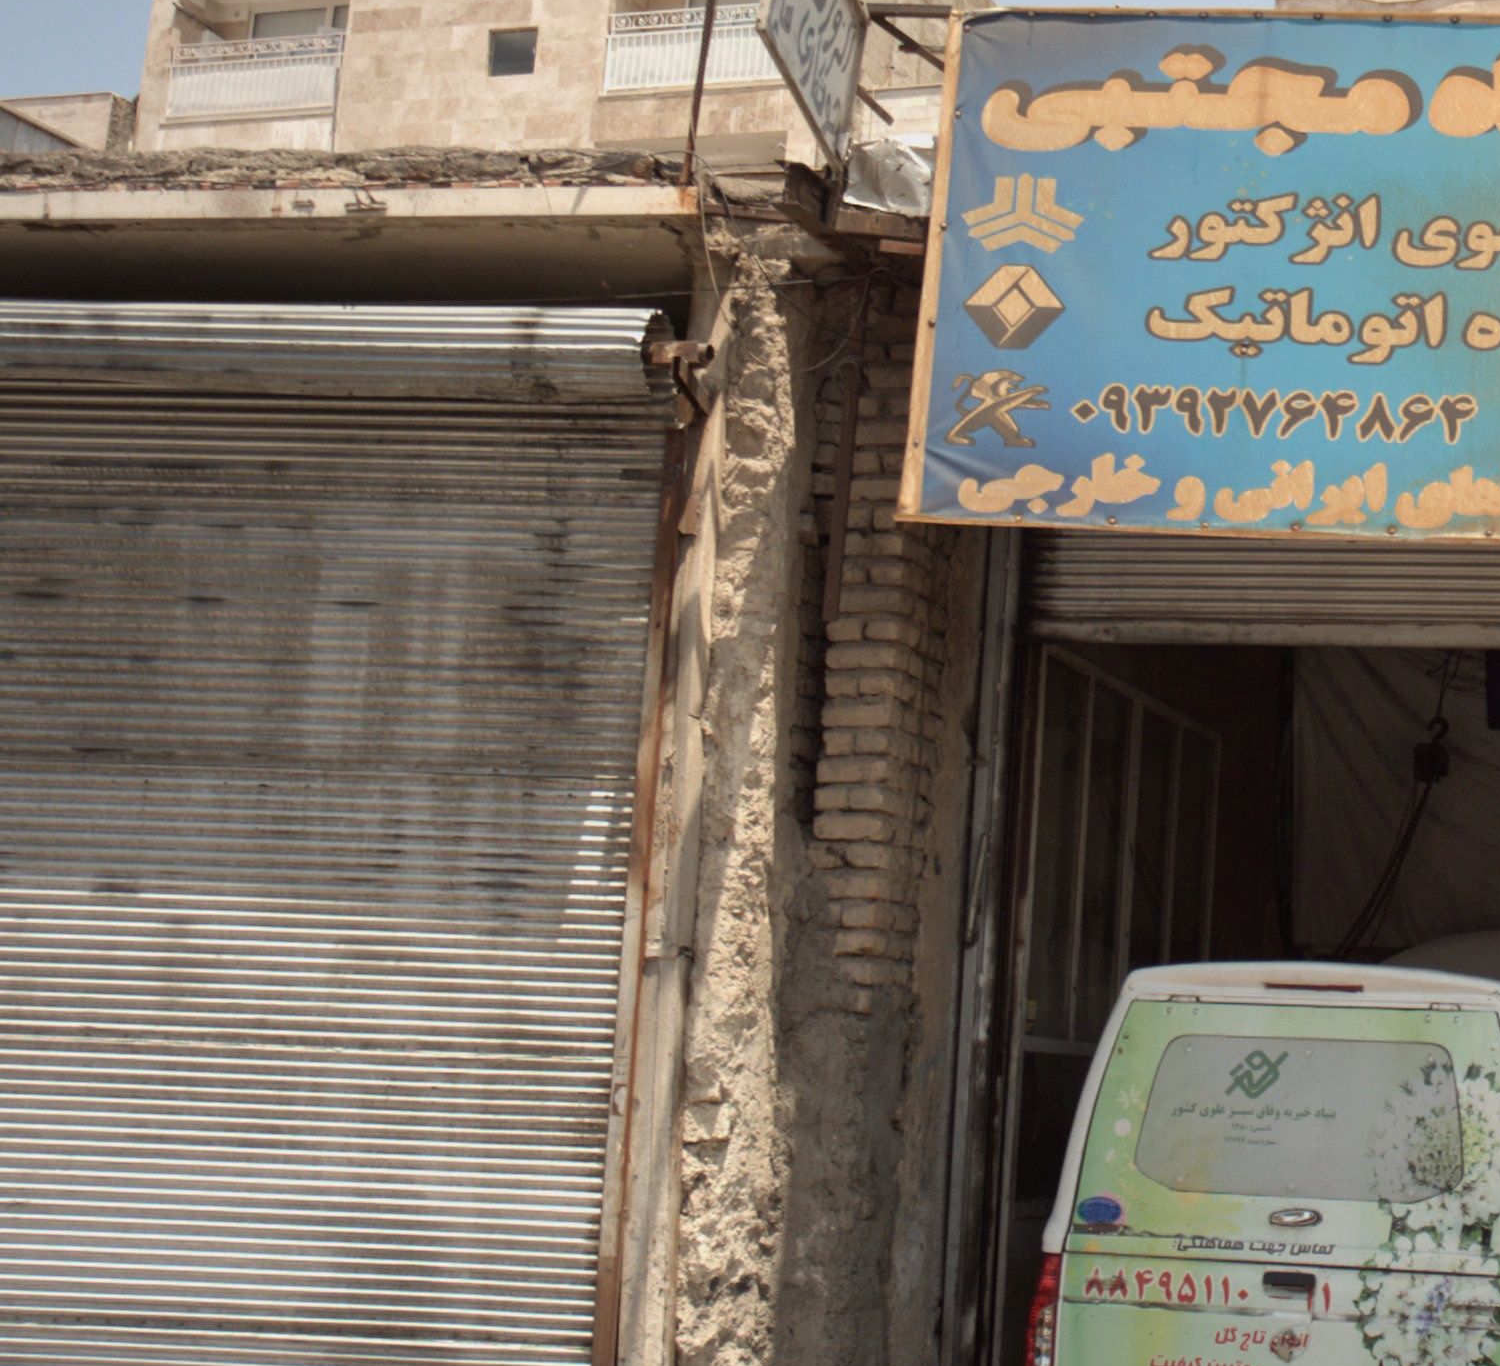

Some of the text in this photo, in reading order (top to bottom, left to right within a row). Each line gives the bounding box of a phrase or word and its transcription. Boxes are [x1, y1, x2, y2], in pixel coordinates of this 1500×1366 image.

[981, 45, 1420, 158] مجتبی
[1148, 192, 1381, 264] انژکتور
[1145, 286, 1448, 365] اتوماتیک
[1071, 383, 1477, 445] ۰۹۳۹۲۷۶۴۸۶۴
[957, 452, 1161, 517] خارجی
[1166, 475, 1206, 521] و
[1214, 459, 1388, 524] ایرانی
[1249, 1240, 1286, 1256] جهت
[1289, 1241, 1335, 1256] تماس
[1215, 1327, 1238, 1345] گل
[1239, 1330, 1266, 1352] تاج
